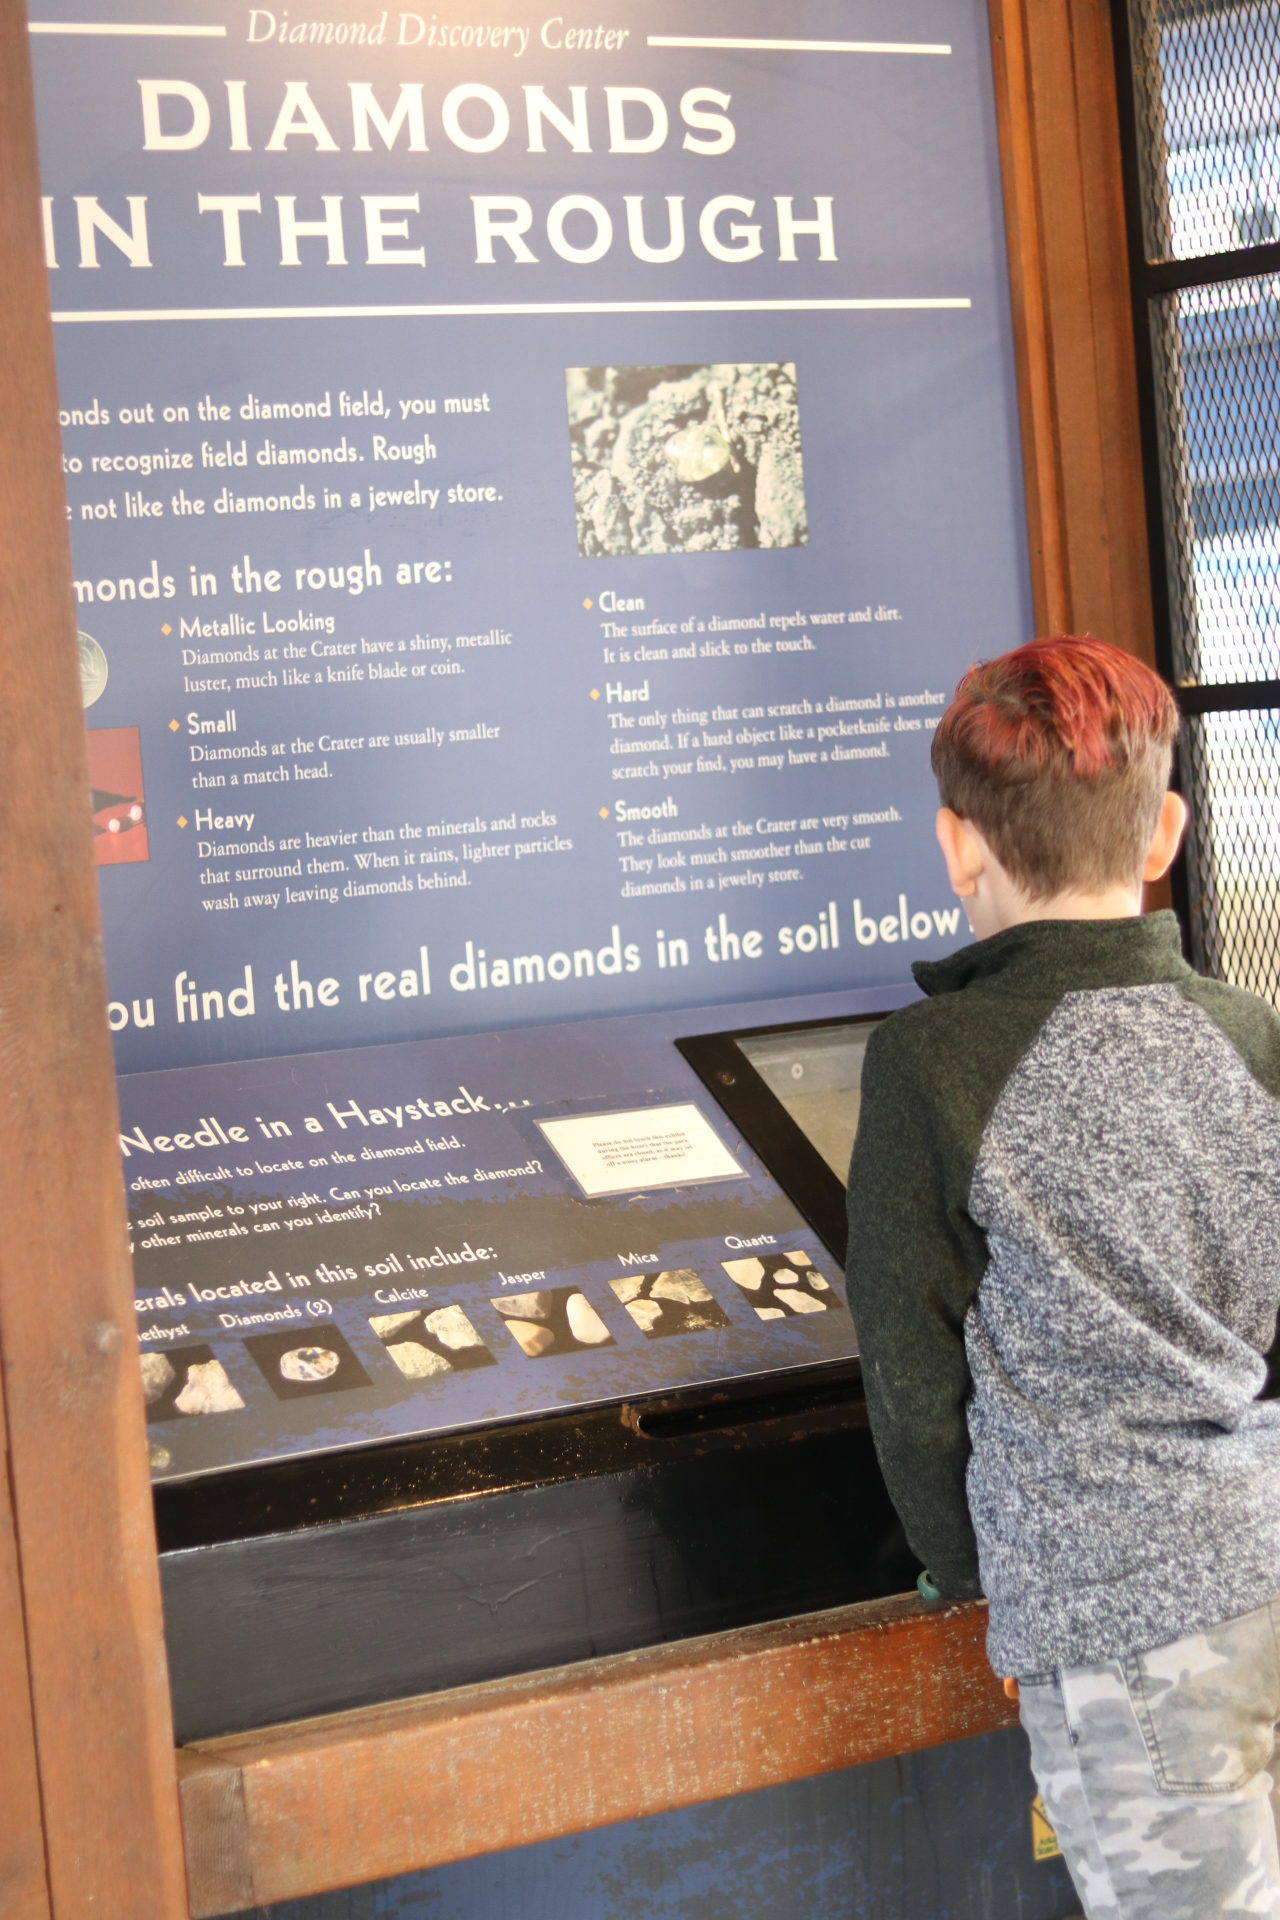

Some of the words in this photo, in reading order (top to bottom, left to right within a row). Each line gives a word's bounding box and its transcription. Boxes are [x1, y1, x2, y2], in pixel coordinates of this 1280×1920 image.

[247, 9, 386, 45] Diamond
[397, 13, 529, 57] Discovery
[541, 17, 629, 51] Center
[137, 78, 737, 155] DIAMONDS
[198, 192, 426, 268] THE
[471, 195, 838, 263] ROUGH
[119, 403, 154, 424] out
[163, 406, 190, 421] on
[198, 395, 232, 421] the
[240, 391, 331, 420] diamond
[339, 390, 391, 419] field,
[399, 399, 436, 420] you
[444, 393, 491, 413] must
[92, 448, 193, 476] recognize
[202, 440, 248, 468] field
[256, 436, 365, 465] diamonds.
[373, 434, 437, 464] Rough
[81, 499, 117, 520] not
[125, 491, 163, 518] like
[171, 489, 205, 516] the
[214, 484, 316, 514] diamonds
[324, 488, 342, 509] in
[350, 493, 361, 508] a
[369, 479, 440, 511] jewelry
[448, 483, 503, 504] store.
[73, 560, 176, 603] monds
[190, 565, 217, 596] in
[232, 555, 281, 594] the
[296, 549, 382, 595] rough
[396, 561, 452, 585] are:
[599, 590, 645, 613] Clean
[180, 613, 256, 639] Metallic
[263, 610, 335, 634] Looking
[600, 622, 628, 638] The
[631, 618, 677, 636] surface
[680, 616, 696, 634] of
[697, 621, 705, 632] a
[708, 612, 766, 632] diamond
[769, 610, 807, 631] repels
[810, 611, 845, 625] water
[848, 606, 872, 622] and
[874, 605, 903, 621] dirt.
[182, 645, 259, 666] Diamonds
[264, 649, 278, 660] at
[283, 642, 307, 659] the
[311, 640, 357, 657] Crater
[361, 638, 394, 653] have
[398, 640, 407, 651] a
[409, 634, 452, 653] shiny,
[456, 629, 512, 648] metallic
[184, 676, 231, 693] luster,
[236, 670, 278, 689] much
[282, 668, 310, 686] like
[314, 671, 323, 684] a
[327, 663, 365, 683] knife
[368, 661, 407, 680] blade
[411, 664, 426, 677] or
[430, 659, 465, 676] coin.
[606, 680, 649, 704] Hard
[187, 710, 236, 735] Small
[190, 740, 267, 762] Diamonds
[272, 744, 286, 755] at
[290, 738, 314, 754] the
[319, 735, 365, 752] Crater
[368, 734, 389, 748] are
[395, 727, 445, 747] usually
[449, 722, 501, 742] smaller
[192, 772, 226, 789] than
[230, 775, 239, 786] a
[243, 765, 289, 785] match
[294, 761, 333, 779] head.
[195, 808, 255, 832] Heavy
[615, 796, 678, 822] Smooth
[617, 831, 644, 847] The
[648, 823, 712, 844] diamonds
[715, 827, 728, 838] at
[732, 820, 753, 836] the
[756, 818, 797, 834] Crater
[800, 818, 818, 830] are
[822, 815, 849, 830] very
[852, 806, 903, 825] smooth.
[197, 835, 275, 858] Diamonds
[280, 838, 301, 851] are
[305, 830, 358, 848] heavier
[363, 826, 394, 842] than
[400, 823, 422, 840] the
[427, 816, 487, 837] minerals
[491, 813, 516, 831] and
[521, 810, 557, 828] rocks
[200, 868, 230, 885] that
[235, 859, 302, 882] surround
[307, 858, 350, 874] them.
[354, 851, 399, 870] When
[404, 850, 415, 865] it
[420, 848, 459, 864] rains,
[463, 842, 510, 863] lighter
[515, 835, 573, 859] particles
[202, 893, 239, 912] wash
[244, 893, 280, 909] away
[286, 885, 339, 904] leaving
[343, 875, 413, 897] diamonds
[417, 869, 471, 890] behind.
[175, 964, 256, 1024] find
[274, 959, 341, 1011] the
[359, 945, 431, 1003] real
[450, 925, 640, 993] diamonds
[656, 929, 689, 969] in
[704, 913, 763, 964] the
[778, 901, 839, 956] soil
[118, 1116, 250, 1157] Needle
[255, 1116, 293, 1139] in
[304, 1117, 324, 1133] a
[130, 1176, 171, 1191] often
[175, 1166, 233, 1185] difficult
[236, 1166, 254, 1178] to
[255, 1161, 304, 1174] locate
[308, 1157, 328, 1168] on
[331, 1151, 356, 1165] the
[360, 1140, 425, 1161] diamond
[425, 1135, 466, 1152] field.
[138, 1212, 165, 1229] soil
[169, 1205, 224, 1223] sample
[227, 1205, 245, 1216] to
[249, 1200, 282, 1215] your
[287, 1192, 327, 1208] right.
[329, 1187, 361, 1201] Can
[364, 1185, 393, 1199] you
[393, 1179, 442, 1193] locate
[444, 1172, 469, 1186] the
[474, 1159, 544, 1182] diamond?
[141, 1233, 181, 1249] other
[186, 1222, 249, 1243] minerals
[253, 1221, 281, 1233] can
[284, 1216, 313, 1231] you
[315, 1202, 382, 1224] identify?
[724, 1234, 777, 1249] Quartz
[134, 1287, 187, 1313] erals
[188, 1271, 282, 1302] located
[286, 1272, 311, 1288] in
[315, 1263, 358, 1283] this
[364, 1253, 404, 1277] soil
[406, 1242, 498, 1271] include:
[498, 1269, 546, 1287] Jasper
[617, 1252, 659, 1267] Mica
[219, 1305, 302, 1328] Diamonds
[306, 1299, 333, 1317] (2)
[374, 1288, 429, 1304] Calcite
[138, 1324, 190, 1342] ethyst
